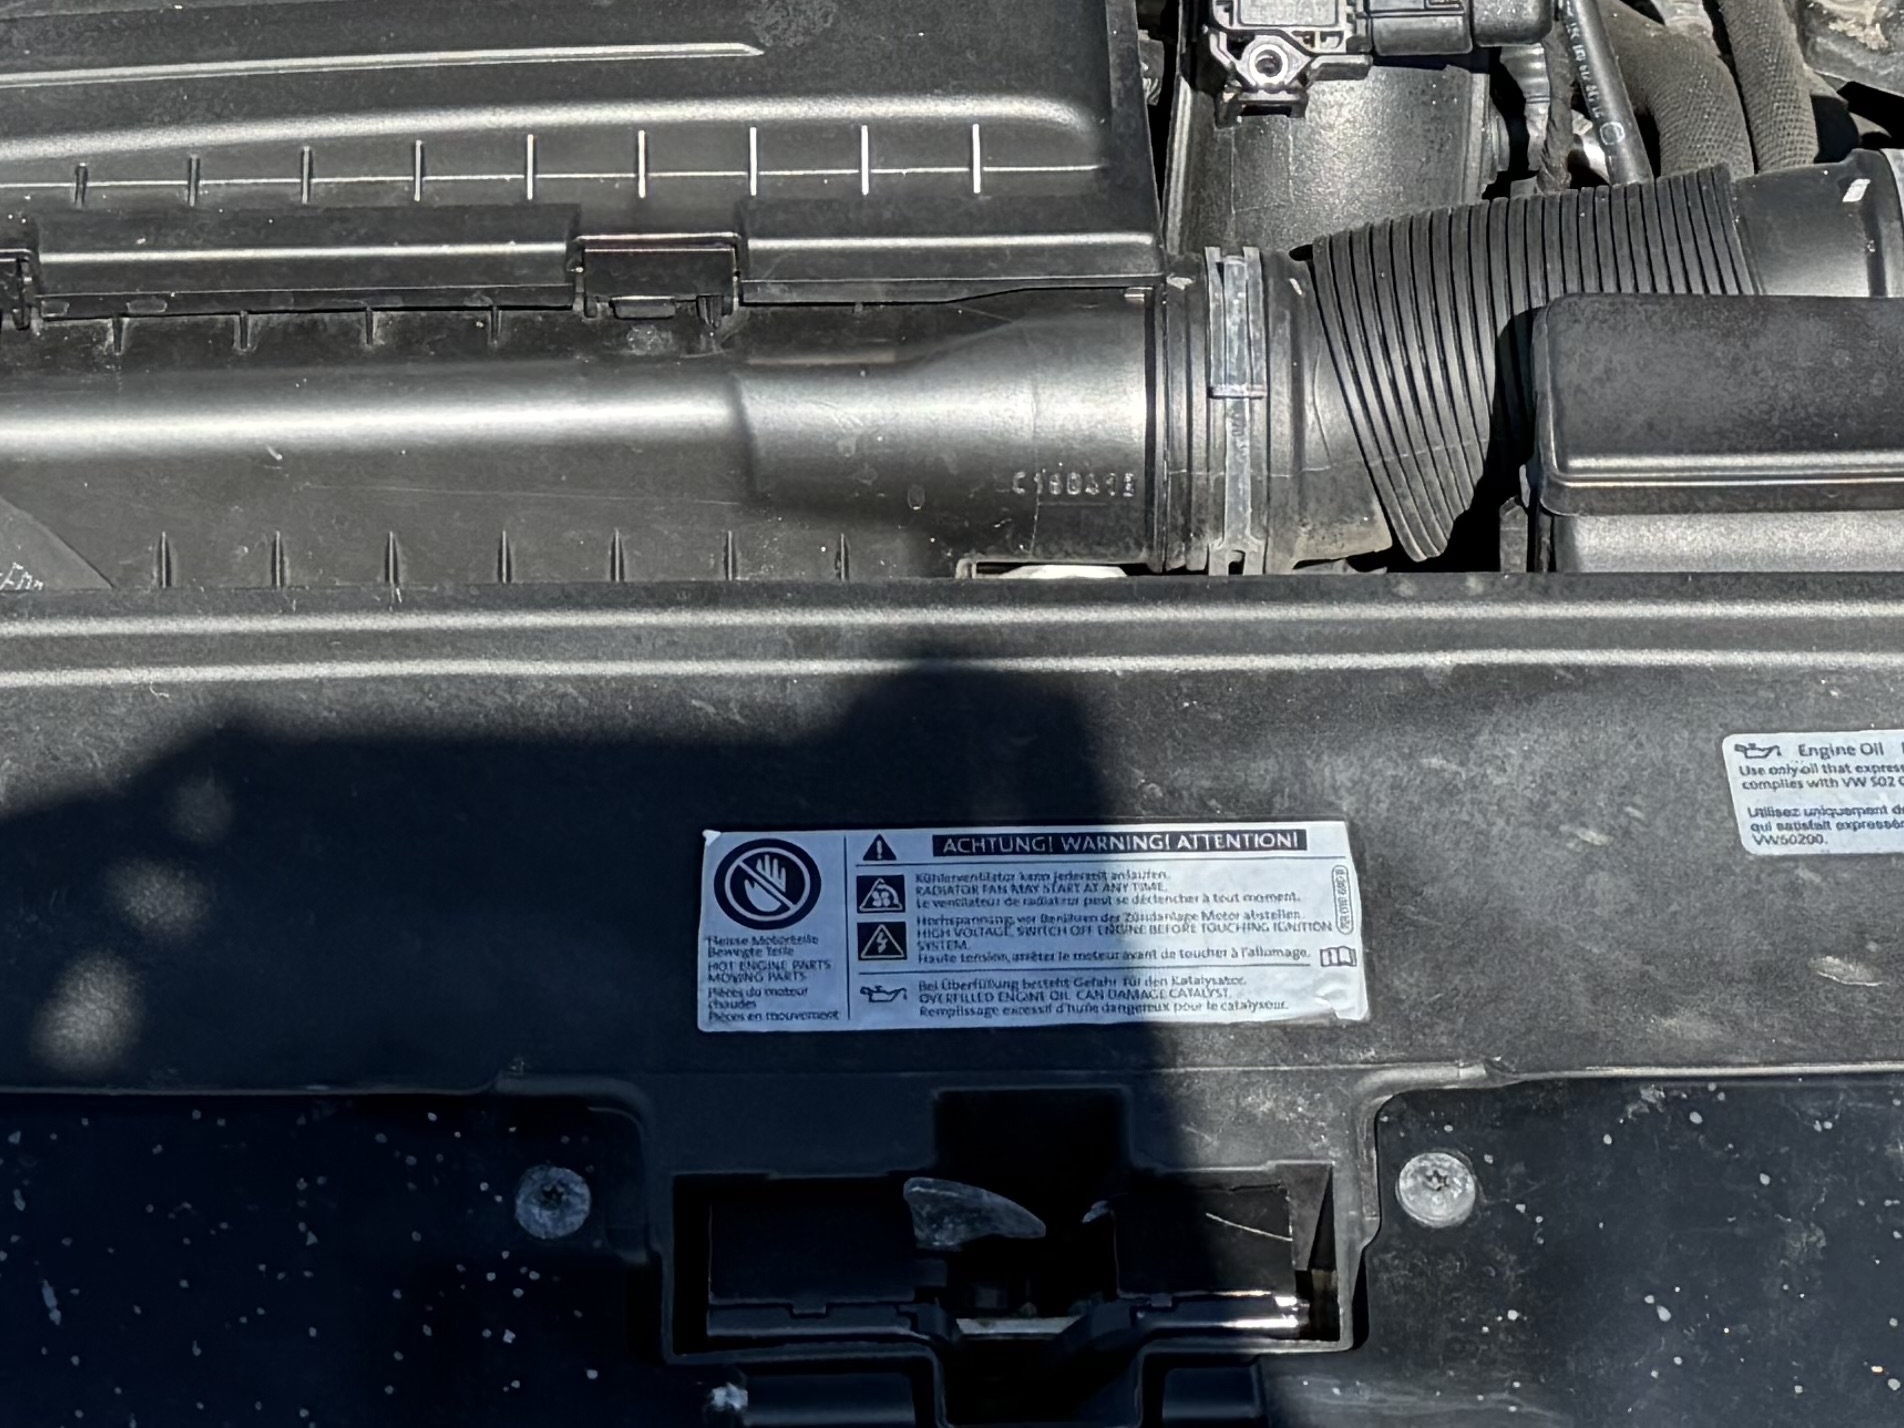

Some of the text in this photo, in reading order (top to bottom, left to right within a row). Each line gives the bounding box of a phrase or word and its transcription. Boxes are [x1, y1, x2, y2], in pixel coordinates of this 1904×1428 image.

[1798, 744, 1856, 760] Engine
[1860, 742, 1884, 756] Oil
[1739, 765, 1765, 776] Use
[1769, 764, 1798, 777] only
[1800, 763, 1818, 775] oil
[1823, 762, 1851, 774] that
[1742, 778, 1804, 793] complies
[1806, 777, 1839, 788] with
[1841, 776, 1868, 787] VW
[1871, 776, 1896, 787] 502
[1747, 806, 1800, 818] Utilisez
[1803, 804, 1888, 820] uniquement
[1751, 823, 1772, 834] qui
[1777, 820, 1832, 831] satisfait
[943, 832, 1298, 853] ACHTUNG! WARNING! ATTENTION!
[915, 885, 979, 896] RADIATOR
[983, 885, 1007, 895] FAN
[1012, 884, 1039, 895] MAY
[1043, 884, 1080, 894] START
[1084, 884, 1098, 893] AT
[1103, 882, 1129, 893] ANY
[933, 897, 1000, 908] ventilateur
[1005, 897, 1020, 907] de
[1023, 896, 1079, 906] radiateur
[1084, 896, 1112, 908] peut
[1116, 897, 1129, 905] se
[1132, 894, 1199, 905] déclencher
[1214, 894, 1239, 903] tout
[1242, 893, 1301, 902] moment.
[1201, 910, 1240, 921] Motor
[917, 928, 950, 939] HIGH
[1017, 927, 1067, 937] SWITCH
[1071, 926, 1093, 937] OFF
[1098, 924, 1146, 935] ENGINE
[1149, 923, 1196, 934] BEFORE
[1201, 922, 1270, 933] TOUCHING
[1274, 921, 1333, 932] IGNITION
[919, 954, 957, 964] Haute
[1059, 951, 1070, 961] le
[1073, 951, 1119, 961] moteur
[1122, 950, 1157, 960] avant
[1161, 949, 1176, 959] de
[1180, 948, 1228, 959] toucher
[708, 960, 831, 971] HOT ENGINE PARTS
[708, 972, 806, 983] MOVING PARTS
[919, 981, 938, 991] Bei
[1022, 978, 1070, 989] besteht
[1074, 977, 1118, 988] Gefahr
[1122, 976, 1141, 987] für
[1144, 976, 1167, 986] den
[746, 987, 761, 997] du
[764, 987, 808, 997] moteur
[919, 992, 994, 1003] OVERFILLED
[998, 991, 1046, 1002] ENGINE
[1076, 990, 1104, 1001] CAN
[1108, 989, 1165, 1000] DAMAGE
[708, 999, 757, 1010] chaudes
[919, 1006, 998, 1019] Remplissage
[1002, 1004, 1053, 1015] excessif
[1101, 1002, 1169, 1015] dangereux
[1173, 1002, 1202, 1012] pour
[1206, 1000, 1218, 1011] le
[748, 1013, 763, 1021] en
[766, 1010, 839, 1020] mouvement
